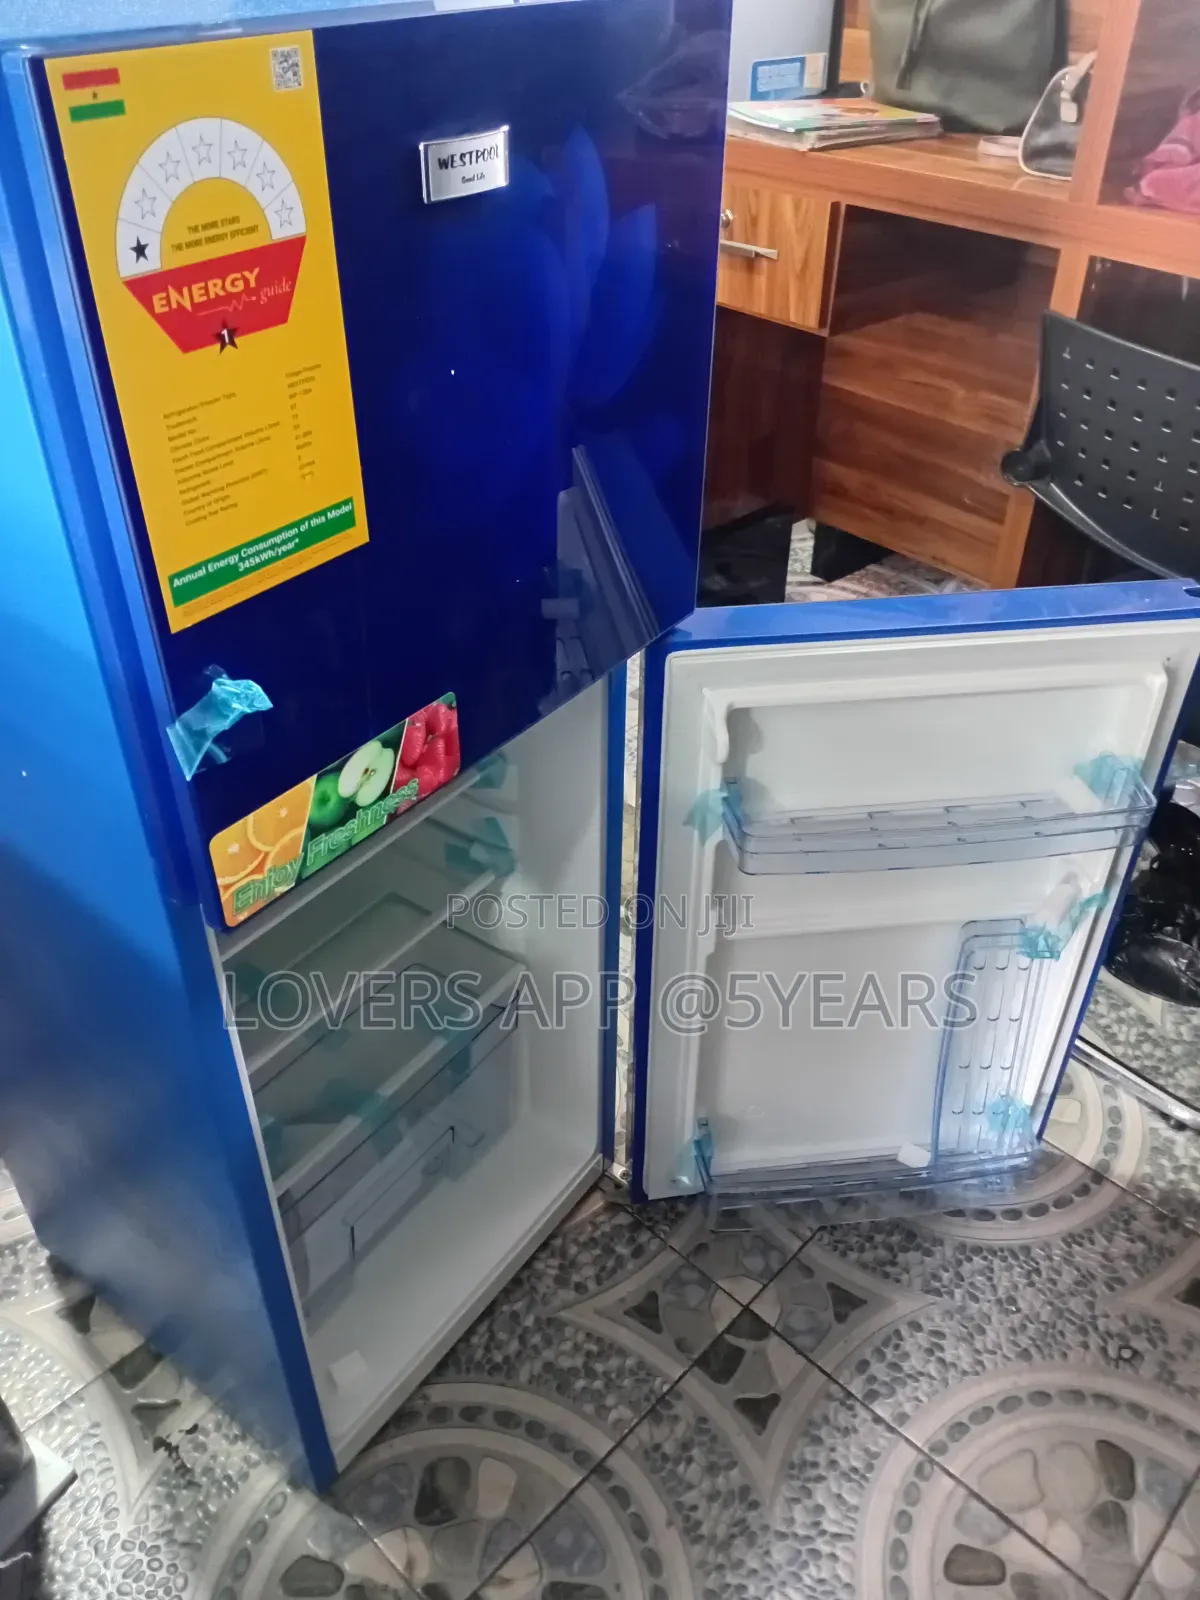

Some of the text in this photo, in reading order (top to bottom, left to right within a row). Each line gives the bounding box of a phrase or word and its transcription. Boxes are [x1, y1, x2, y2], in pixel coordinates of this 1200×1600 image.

[152, 267, 260, 314] ENERGY
[260, 276, 292, 304] guide
[221, 329, 229, 344] 1
[173, 567, 206, 588] Annual
[208, 552, 240, 573] Energy
[240, 526, 299, 558] Consumption
[299, 520, 309, 533] of
[310, 514, 326, 528] this
[327, 502, 353, 520] Model
[233, 778, 420, 916] Enjoy Freshness
